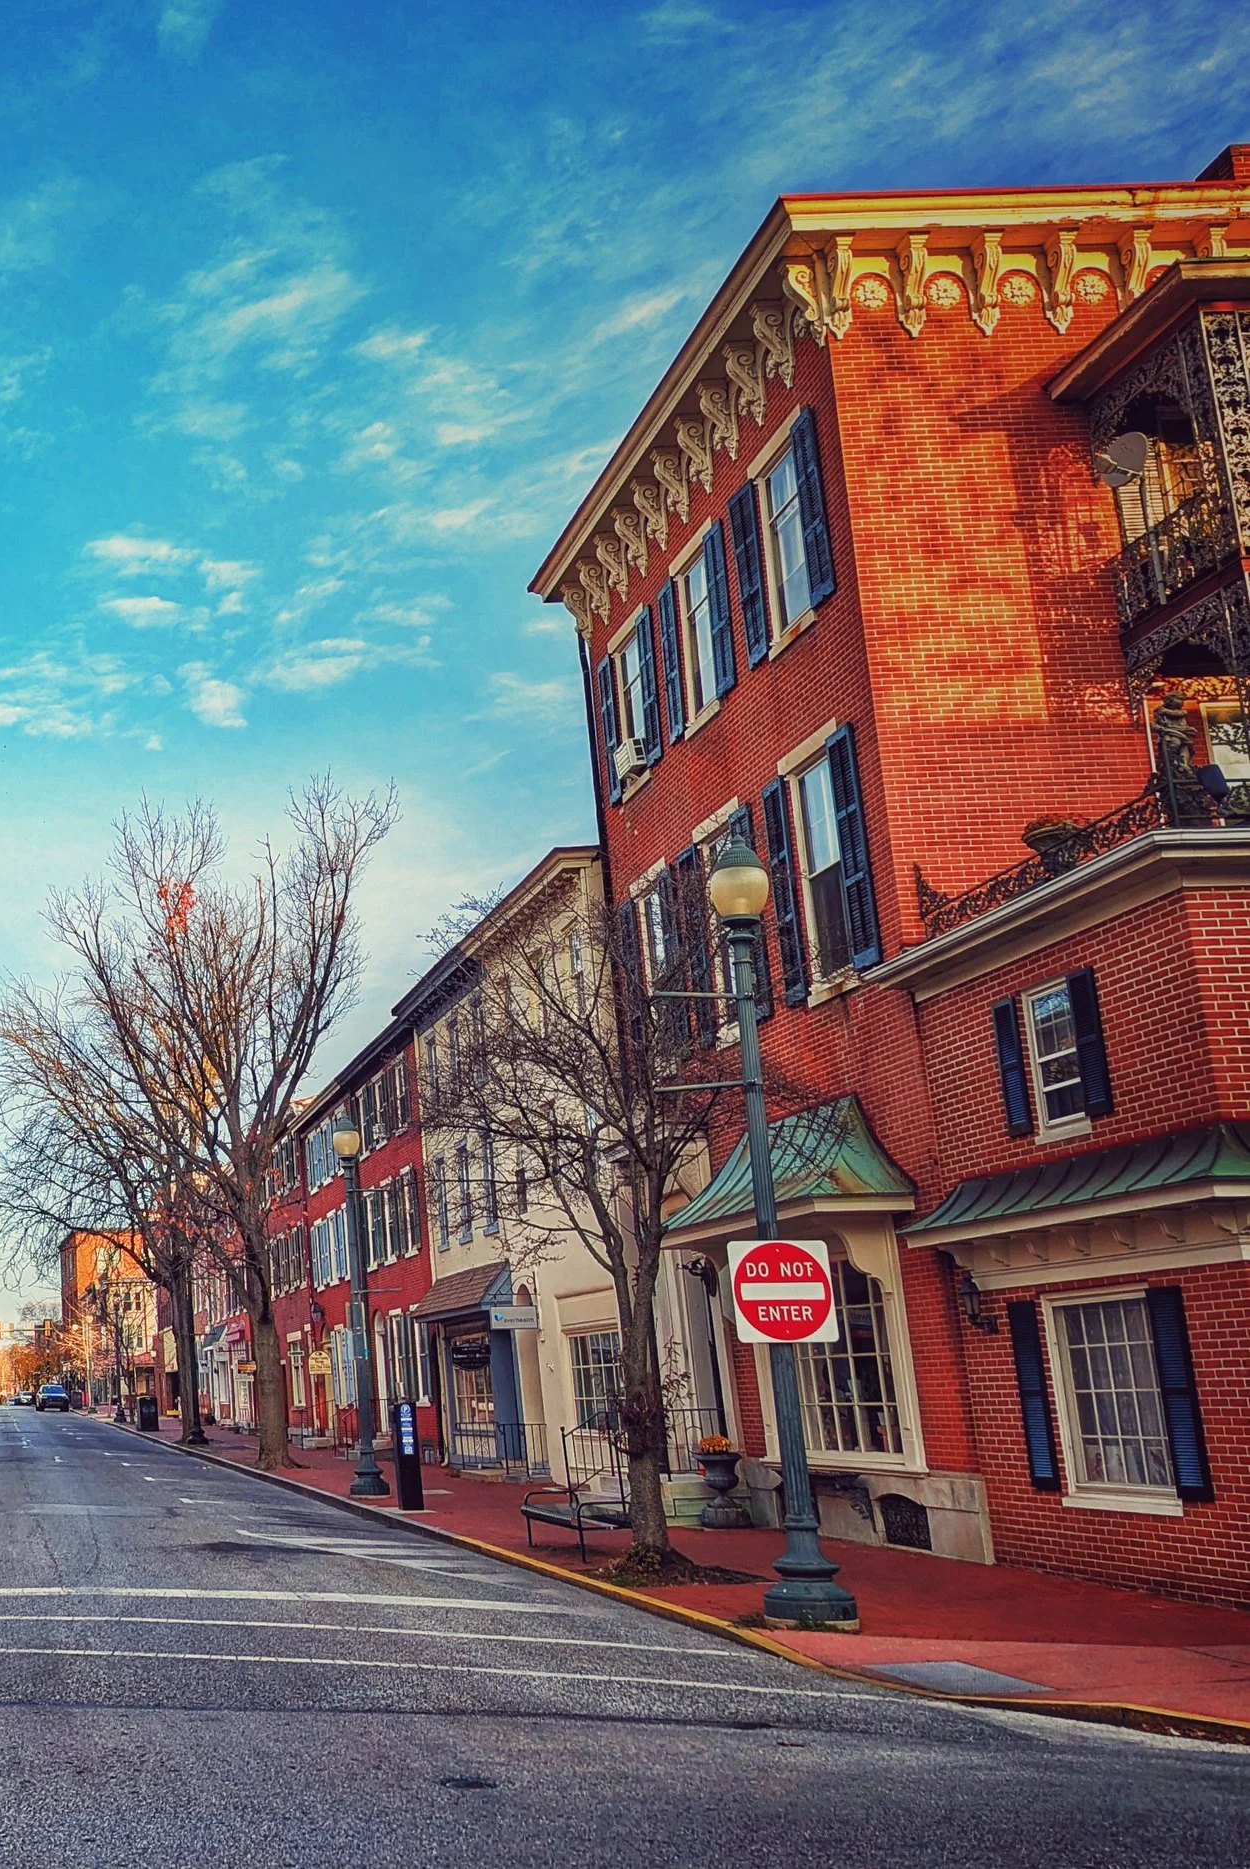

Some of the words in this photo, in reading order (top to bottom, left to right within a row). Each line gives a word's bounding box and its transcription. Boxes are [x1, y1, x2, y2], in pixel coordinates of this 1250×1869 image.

[745, 1262, 769, 1278] DO
[779, 1261, 814, 1278] NOT
[503, 1316, 535, 1324] averhealth
[757, 1306, 814, 1322] ENTER
